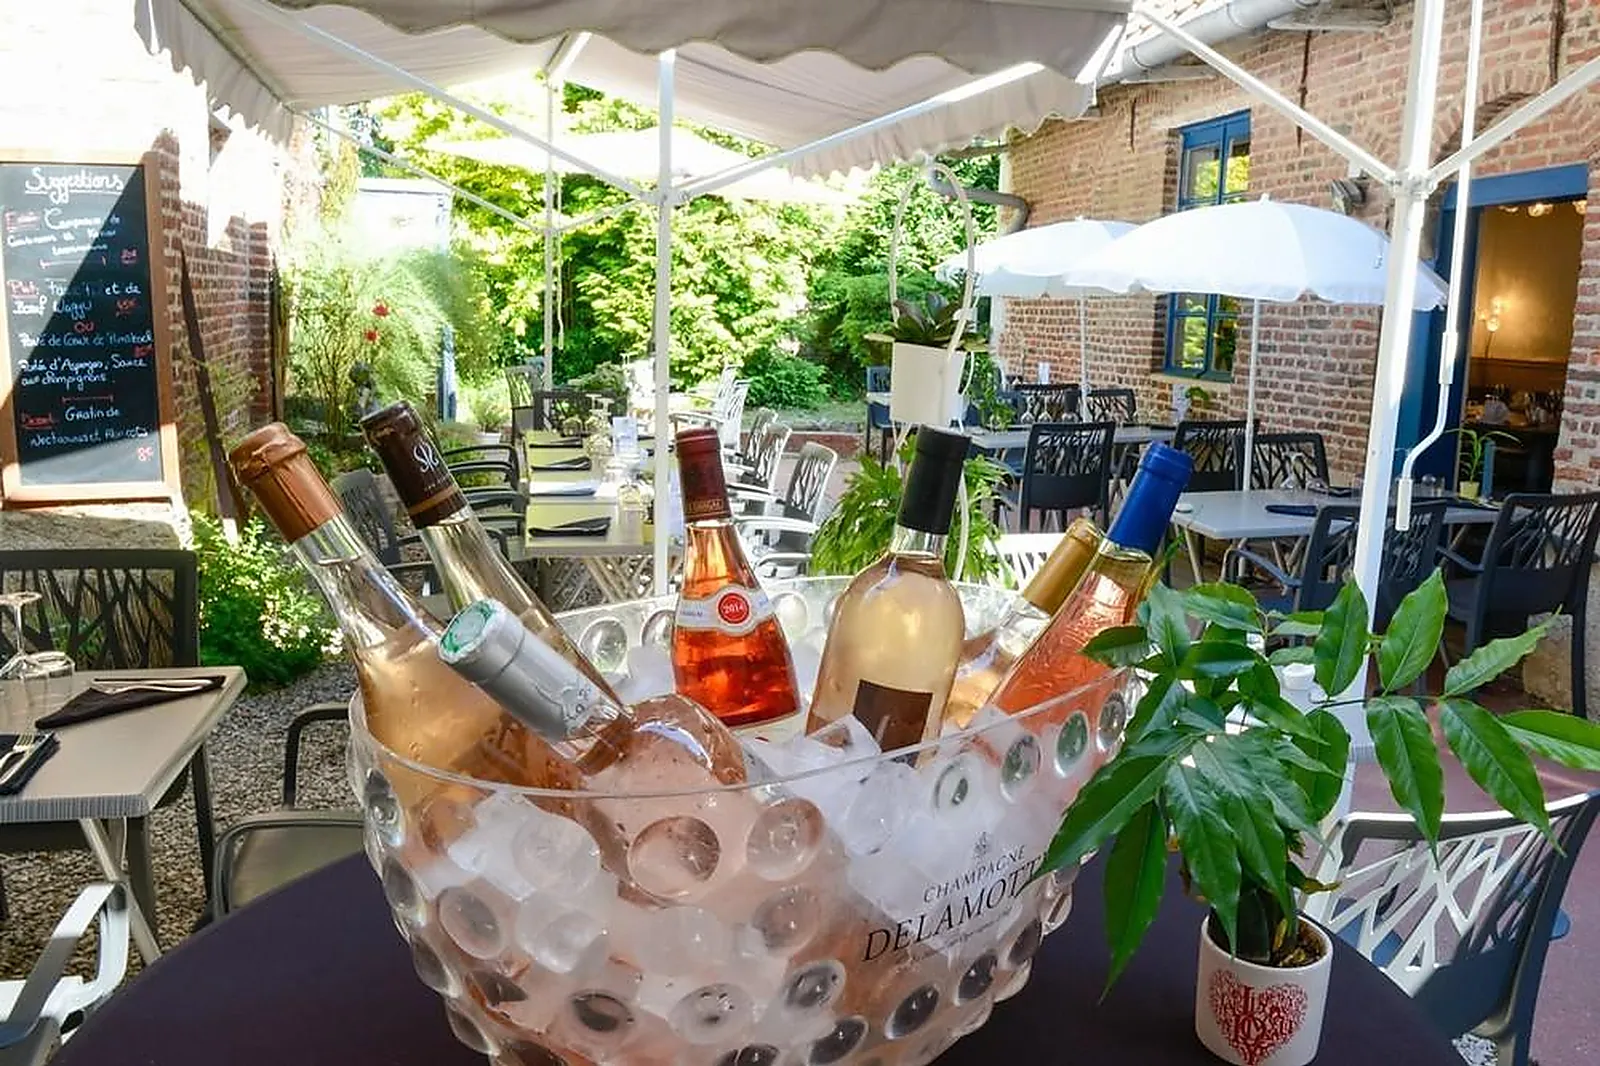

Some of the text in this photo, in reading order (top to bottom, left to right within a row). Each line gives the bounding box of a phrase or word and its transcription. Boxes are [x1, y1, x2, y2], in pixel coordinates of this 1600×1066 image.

[24, 167, 124, 204] Suggestions
[723, 603, 744, 614] 2014
[924, 844, 1025, 904] CHAMPAGNE
[861, 852, 1046, 963] DELAMOTT
